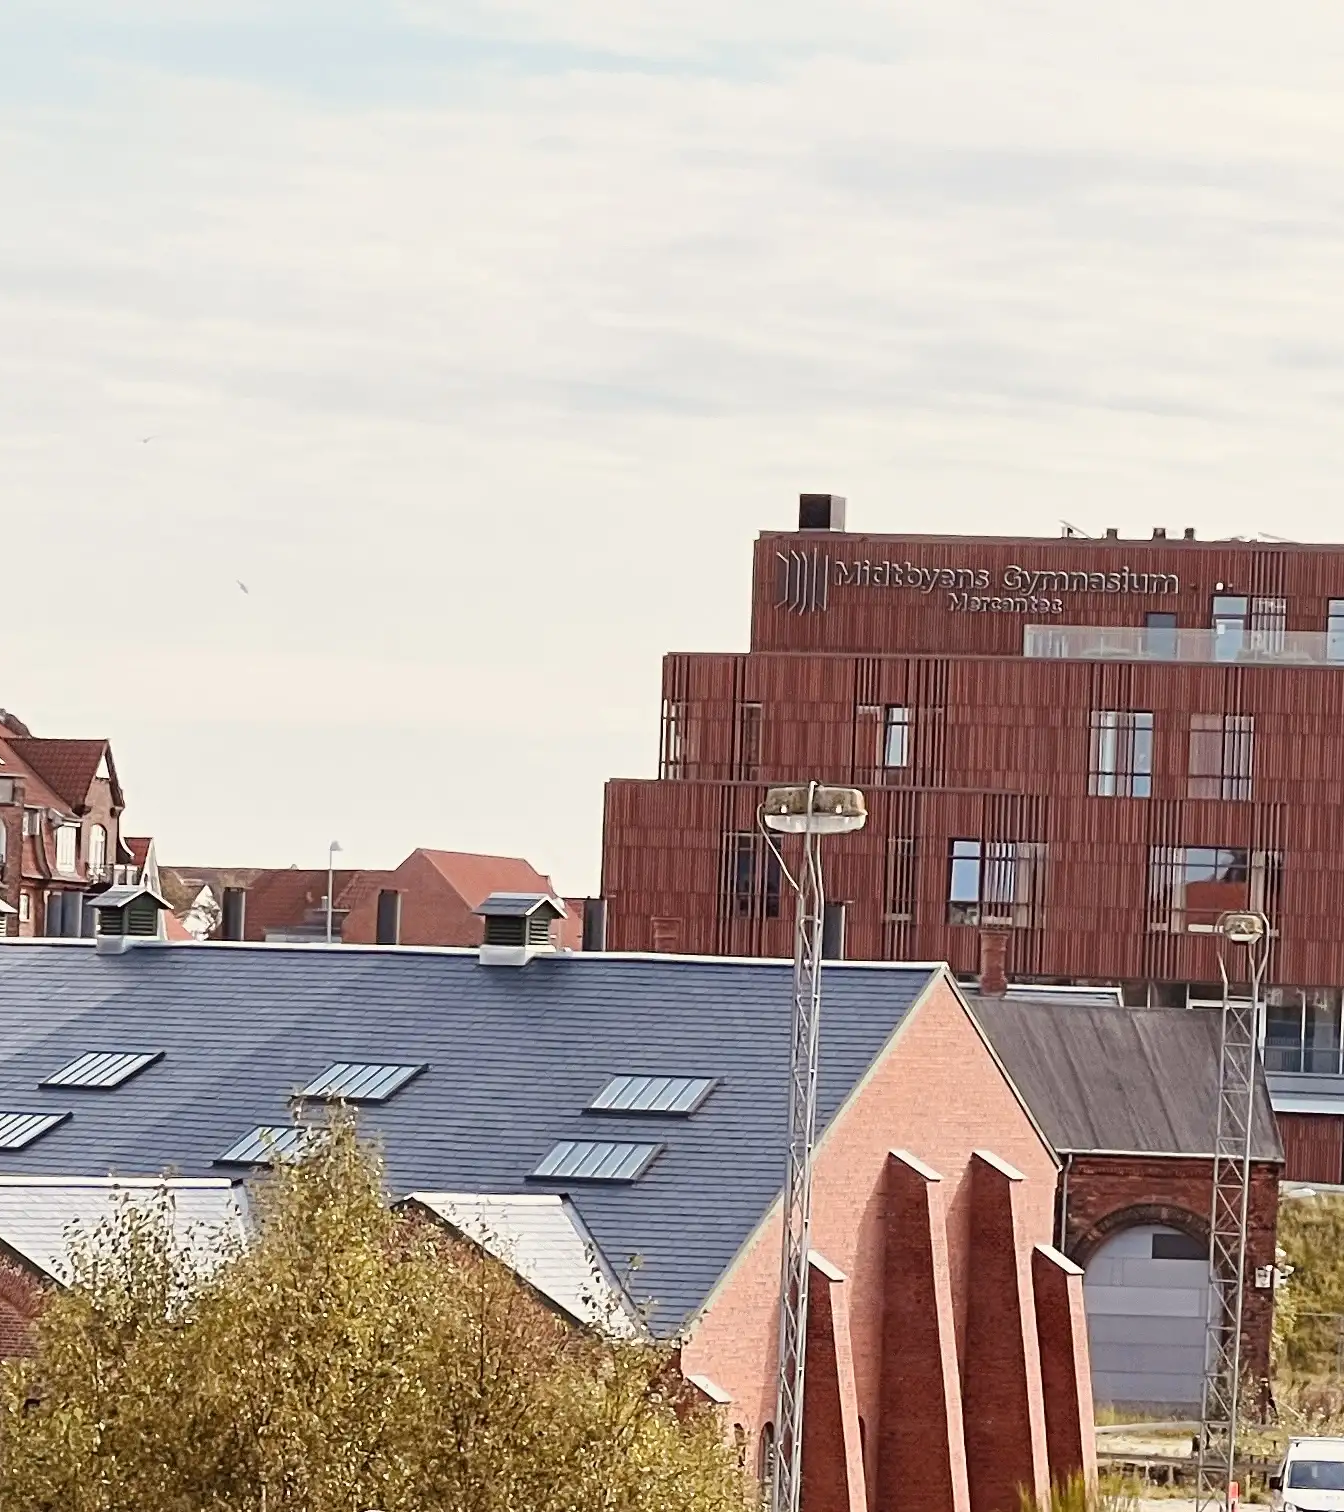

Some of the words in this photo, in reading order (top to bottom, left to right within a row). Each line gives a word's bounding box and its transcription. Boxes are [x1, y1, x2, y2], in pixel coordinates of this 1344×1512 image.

[833, 559, 990, 594] Midtbyens
[1002, 564, 1180, 596] Gymnasium
[947, 592, 1063, 614] Mercantec
